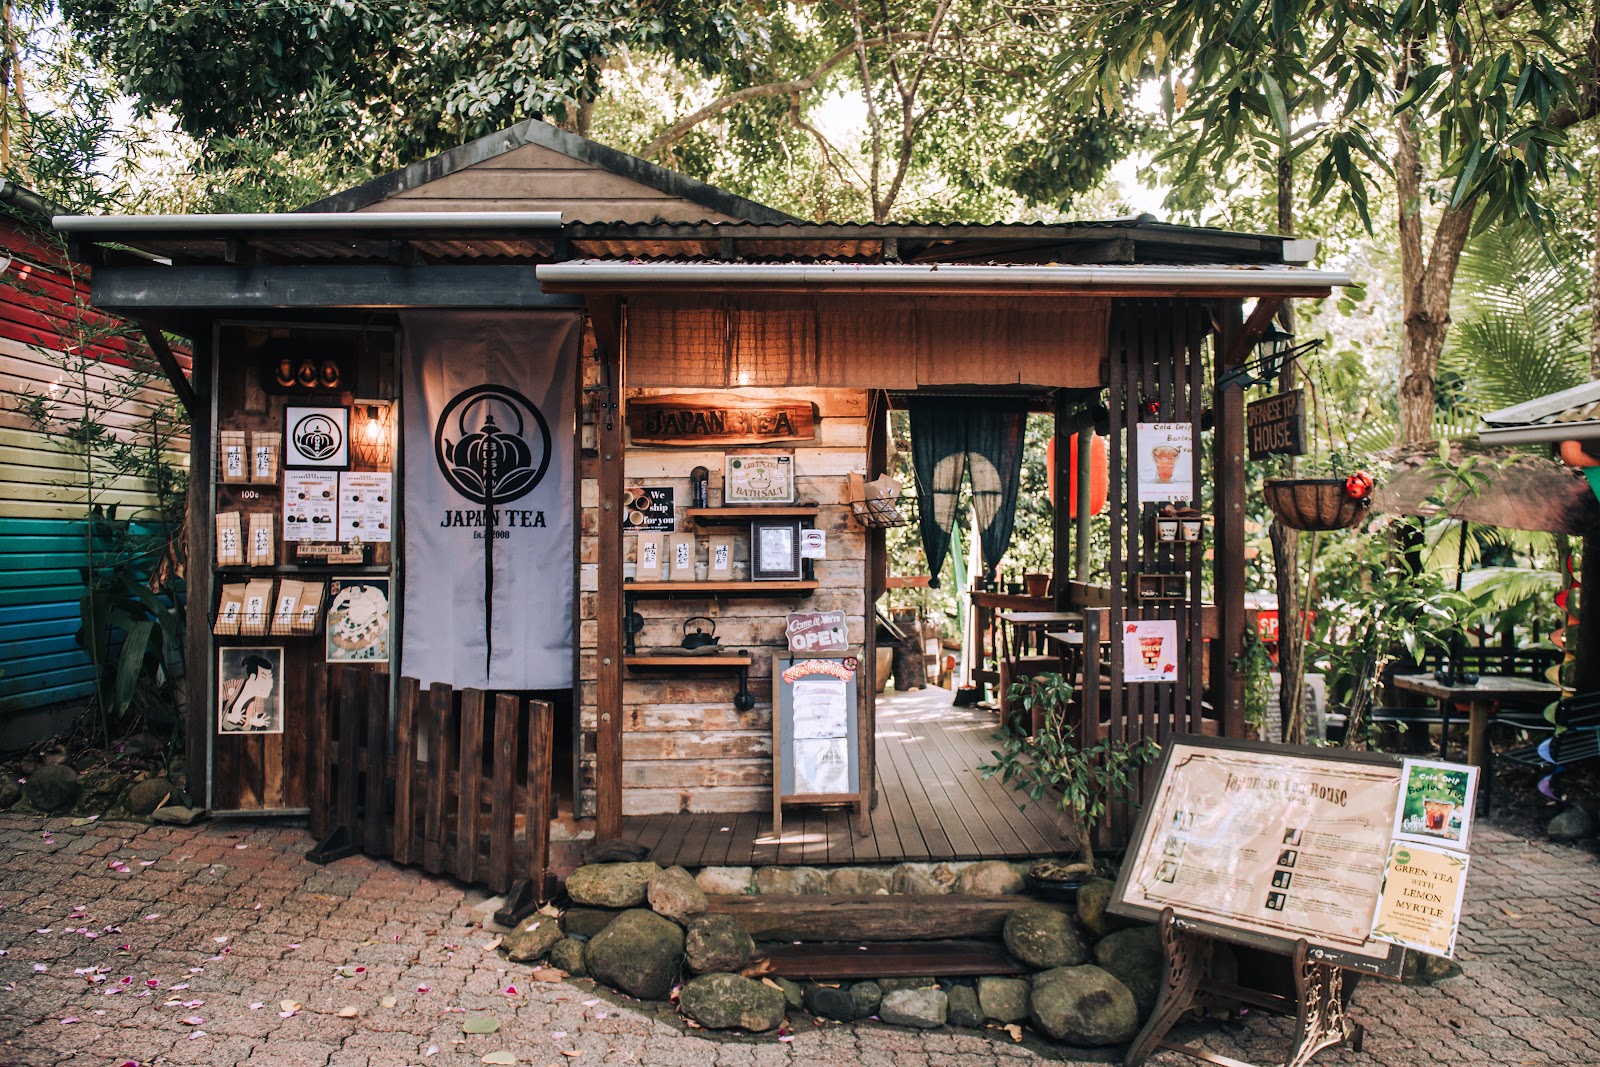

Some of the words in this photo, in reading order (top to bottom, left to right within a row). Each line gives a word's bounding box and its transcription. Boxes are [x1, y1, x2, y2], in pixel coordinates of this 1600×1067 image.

[646, 409, 727, 435] JAPAN
[738, 409, 798, 435] TEA
[1153, 423, 1172, 431] Cold
[1253, 421, 1292, 452] HOUSE
[743, 460, 766, 470] GREEN
[650, 490, 666, 499] We
[735, 487, 760, 498] BATH
[761, 486, 784, 498] SALT
[649, 503, 669, 514] ship
[440, 509, 500, 528] JAPAN
[505, 509, 547, 528] TEA
[642, 515, 657, 525] for
[657, 517, 675, 527] you
[490, 530, 511, 540] 2008
[789, 619, 813, 633] Come
[820, 615, 841, 625] We're
[791, 628, 845, 650] OPEN
[1418, 773, 1439, 781] Cold
[1441, 775, 1461, 786] Drip
[1310, 781, 1348, 808] House
[1408, 784, 1441, 795] Barley
[1447, 787, 1465, 802] Tea
[1394, 864, 1428, 877] GREEN
[1432, 871, 1454, 884] TEA
[1411, 878, 1435, 890] WITH
[1403, 888, 1442, 904] LEMON
[1395, 899, 1444, 919] MYRTLE
